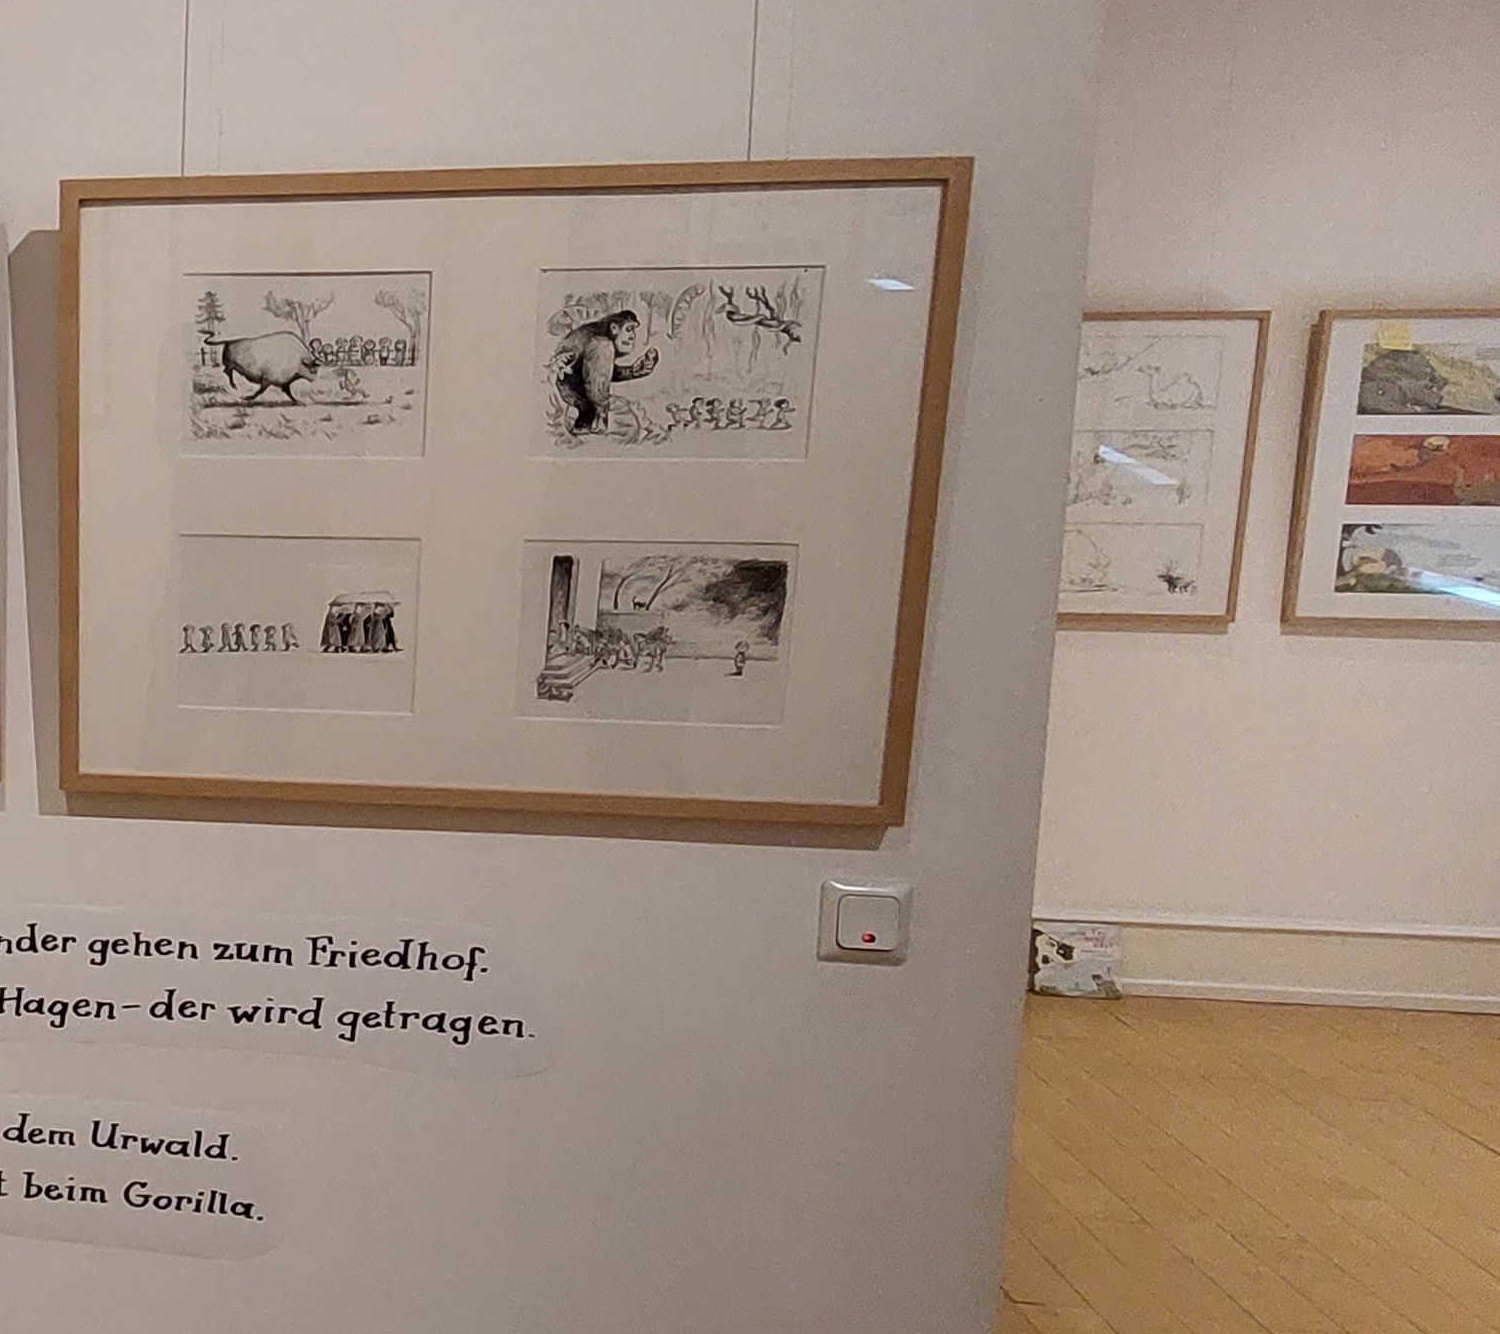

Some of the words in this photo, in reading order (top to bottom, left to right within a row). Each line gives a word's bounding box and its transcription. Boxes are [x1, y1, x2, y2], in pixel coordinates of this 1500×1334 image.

[87, 931, 199, 967] gehen
[212, 942, 294, 967] zum
[305, 935, 489, 982] Friedhof.
[226, 996, 325, 1030] wird
[336, 1000, 535, 1046] getragen.
[2, 1112, 77, 1147] dem
[91, 1119, 239, 1162] Urwald.
[22, 1171, 109, 1204] beim
[123, 1180, 264, 1222] Gorilla.
